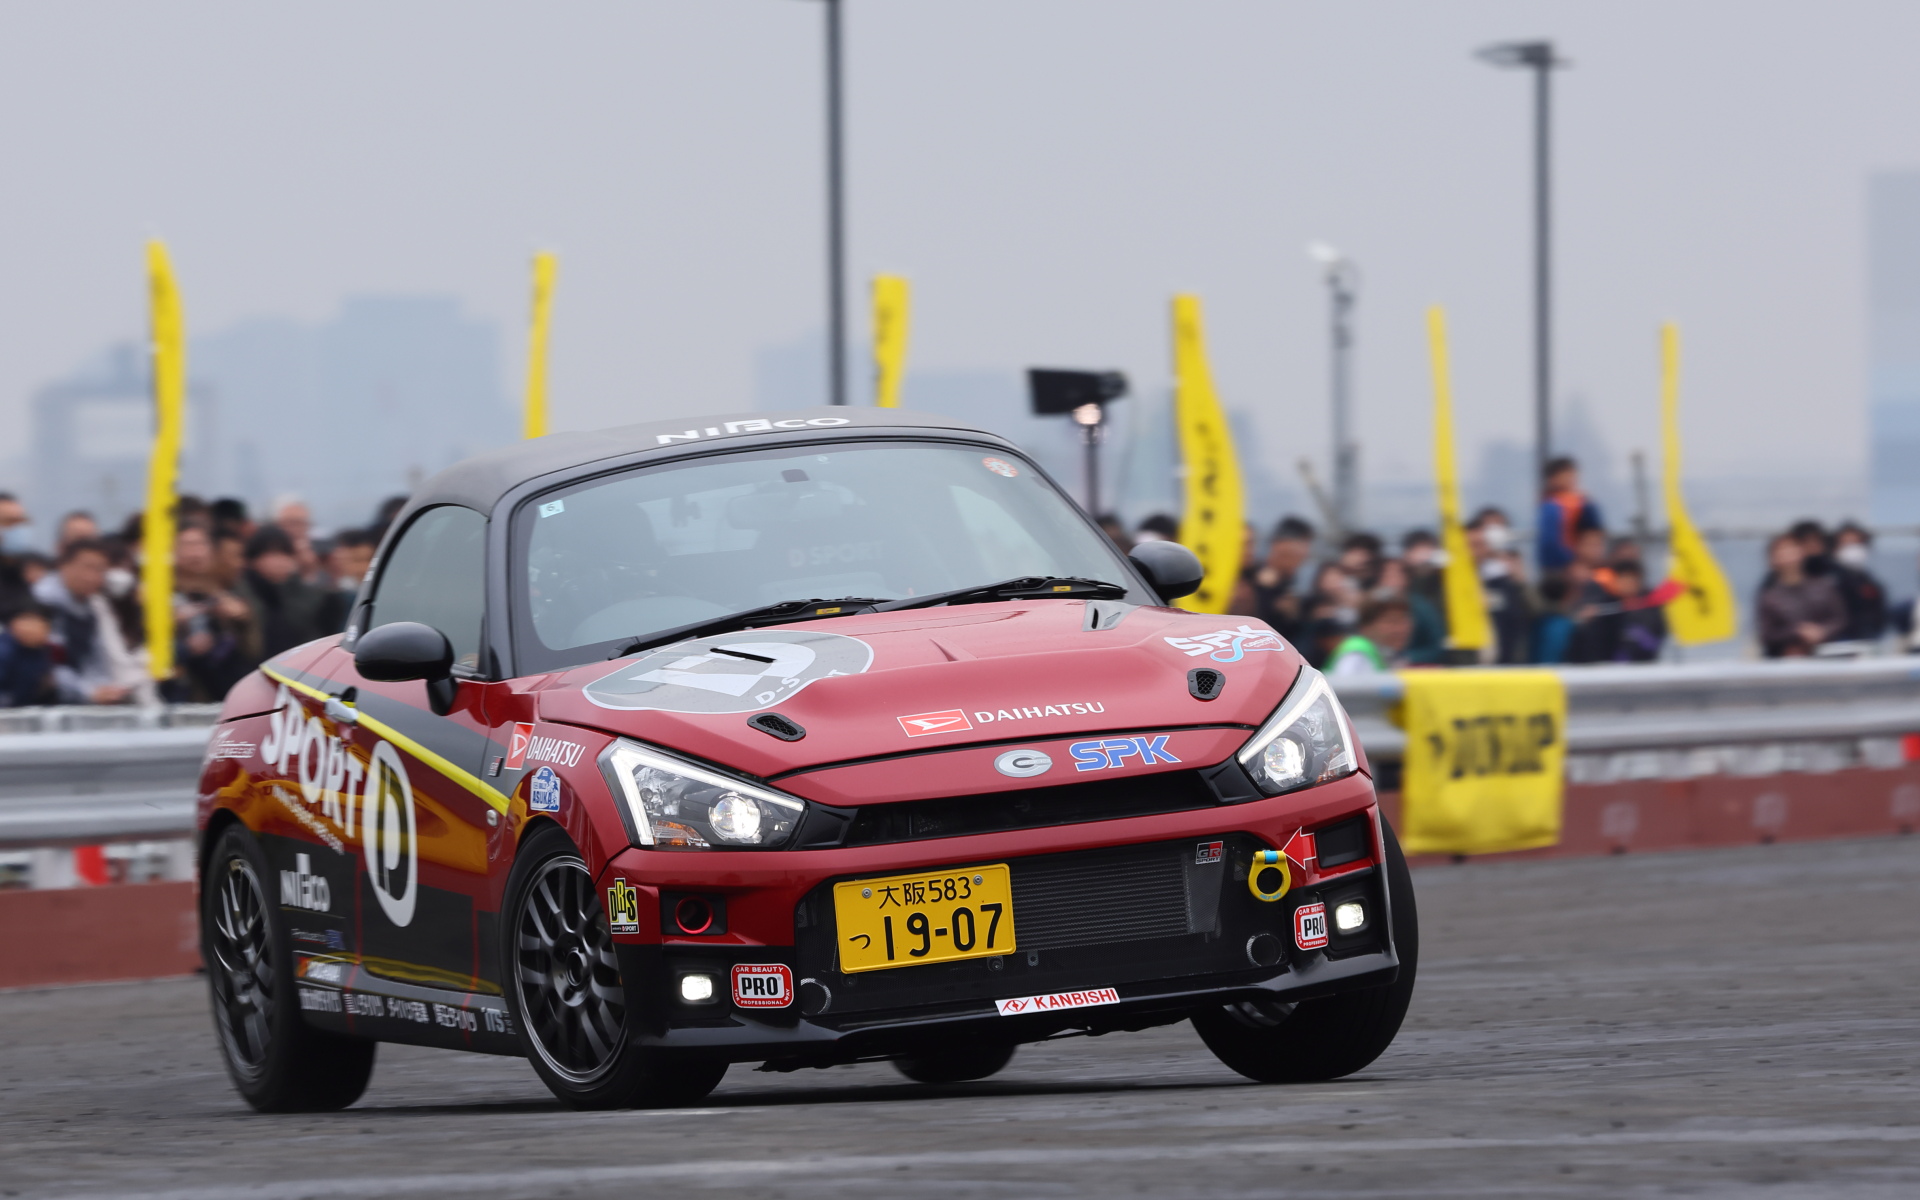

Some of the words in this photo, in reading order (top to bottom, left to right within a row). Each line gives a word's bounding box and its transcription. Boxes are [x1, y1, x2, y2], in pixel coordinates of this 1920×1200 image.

[974, 701, 1105, 724] DAIHATSU
[260, 682, 364, 839] SPORT
[526, 735, 587, 768] DAIHATSU
[1069, 734, 1183, 772] SPK
[610, 881, 636, 921] DRS
[877, 876, 972, 909] 大阪583
[848, 933, 871, 949] つ
[883, 902, 1003, 961] 19-07
[1304, 915, 1325, 937] PRO
[741, 976, 779, 996] PRO
[1033, 988, 1118, 1010] KANBISHI
